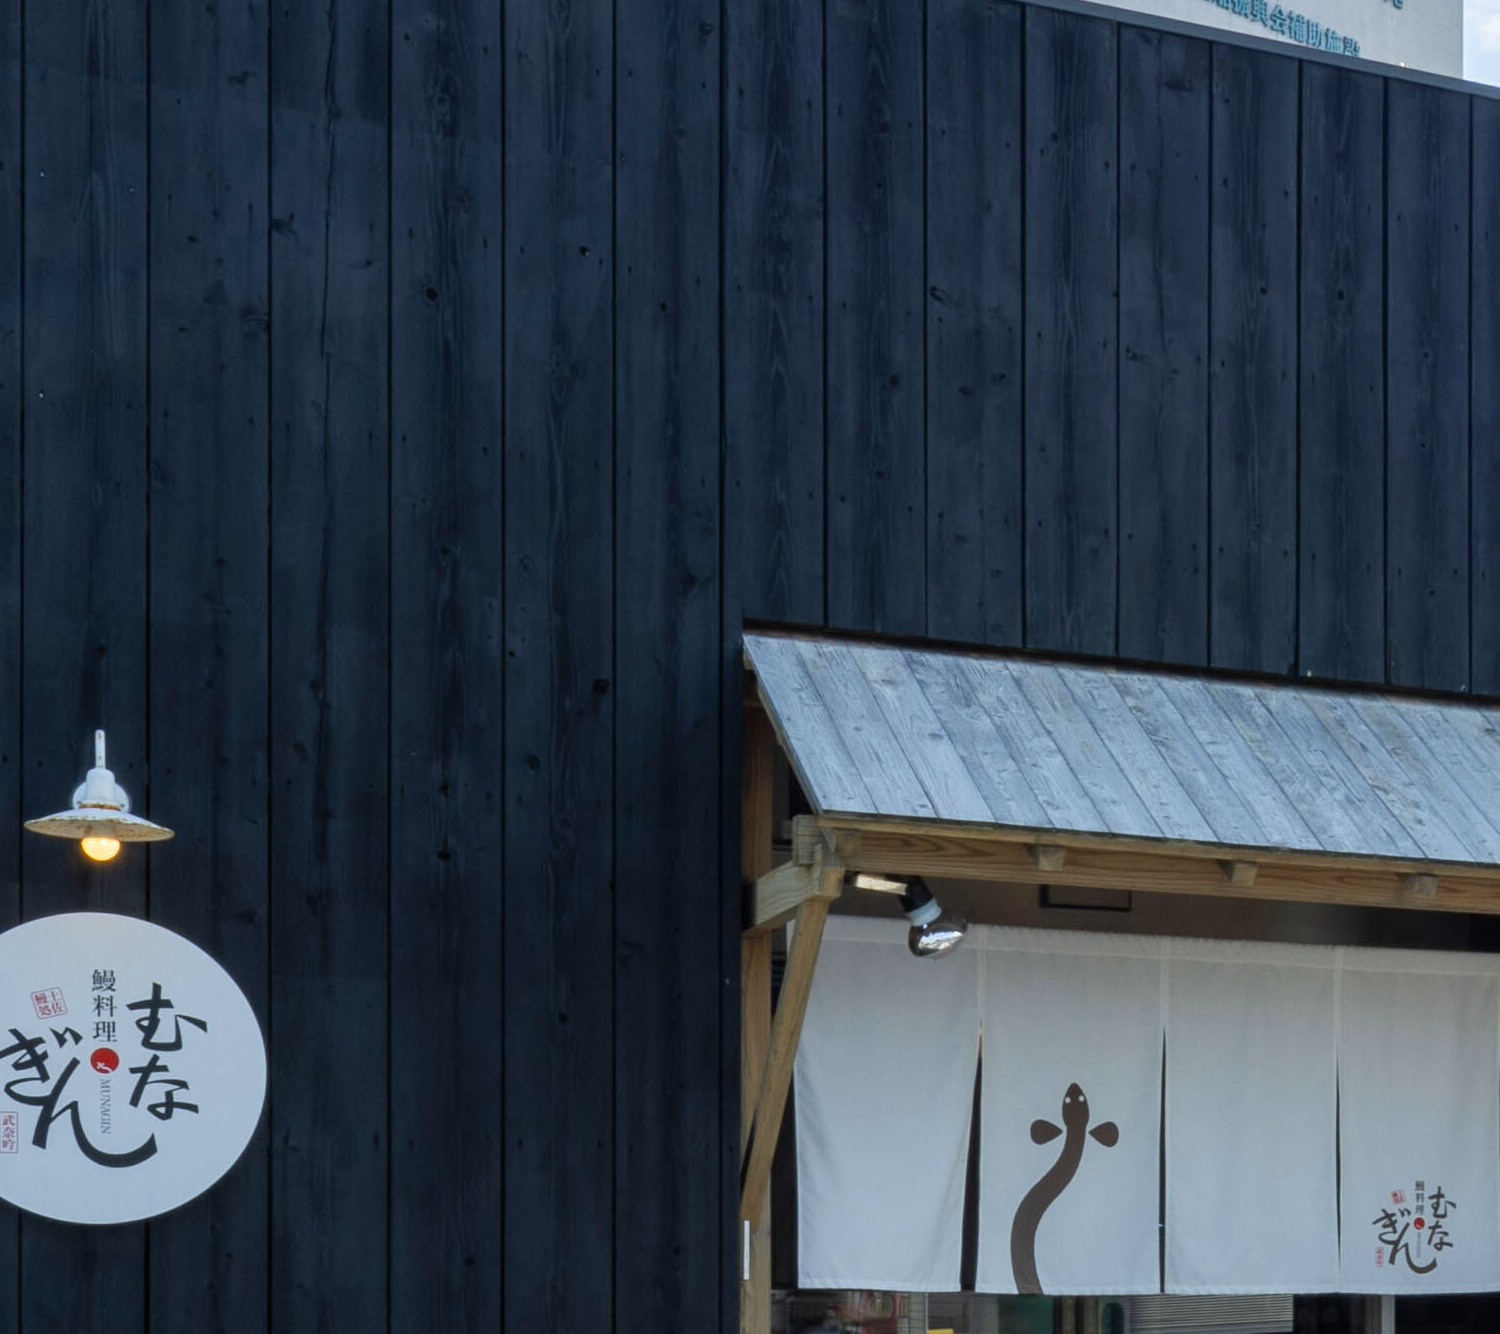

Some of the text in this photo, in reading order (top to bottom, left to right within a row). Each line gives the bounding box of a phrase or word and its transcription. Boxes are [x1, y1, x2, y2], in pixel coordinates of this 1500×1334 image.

[91, 969, 118, 1043] 鰻料理
[100, 1079, 111, 1135] MUNAGIN
